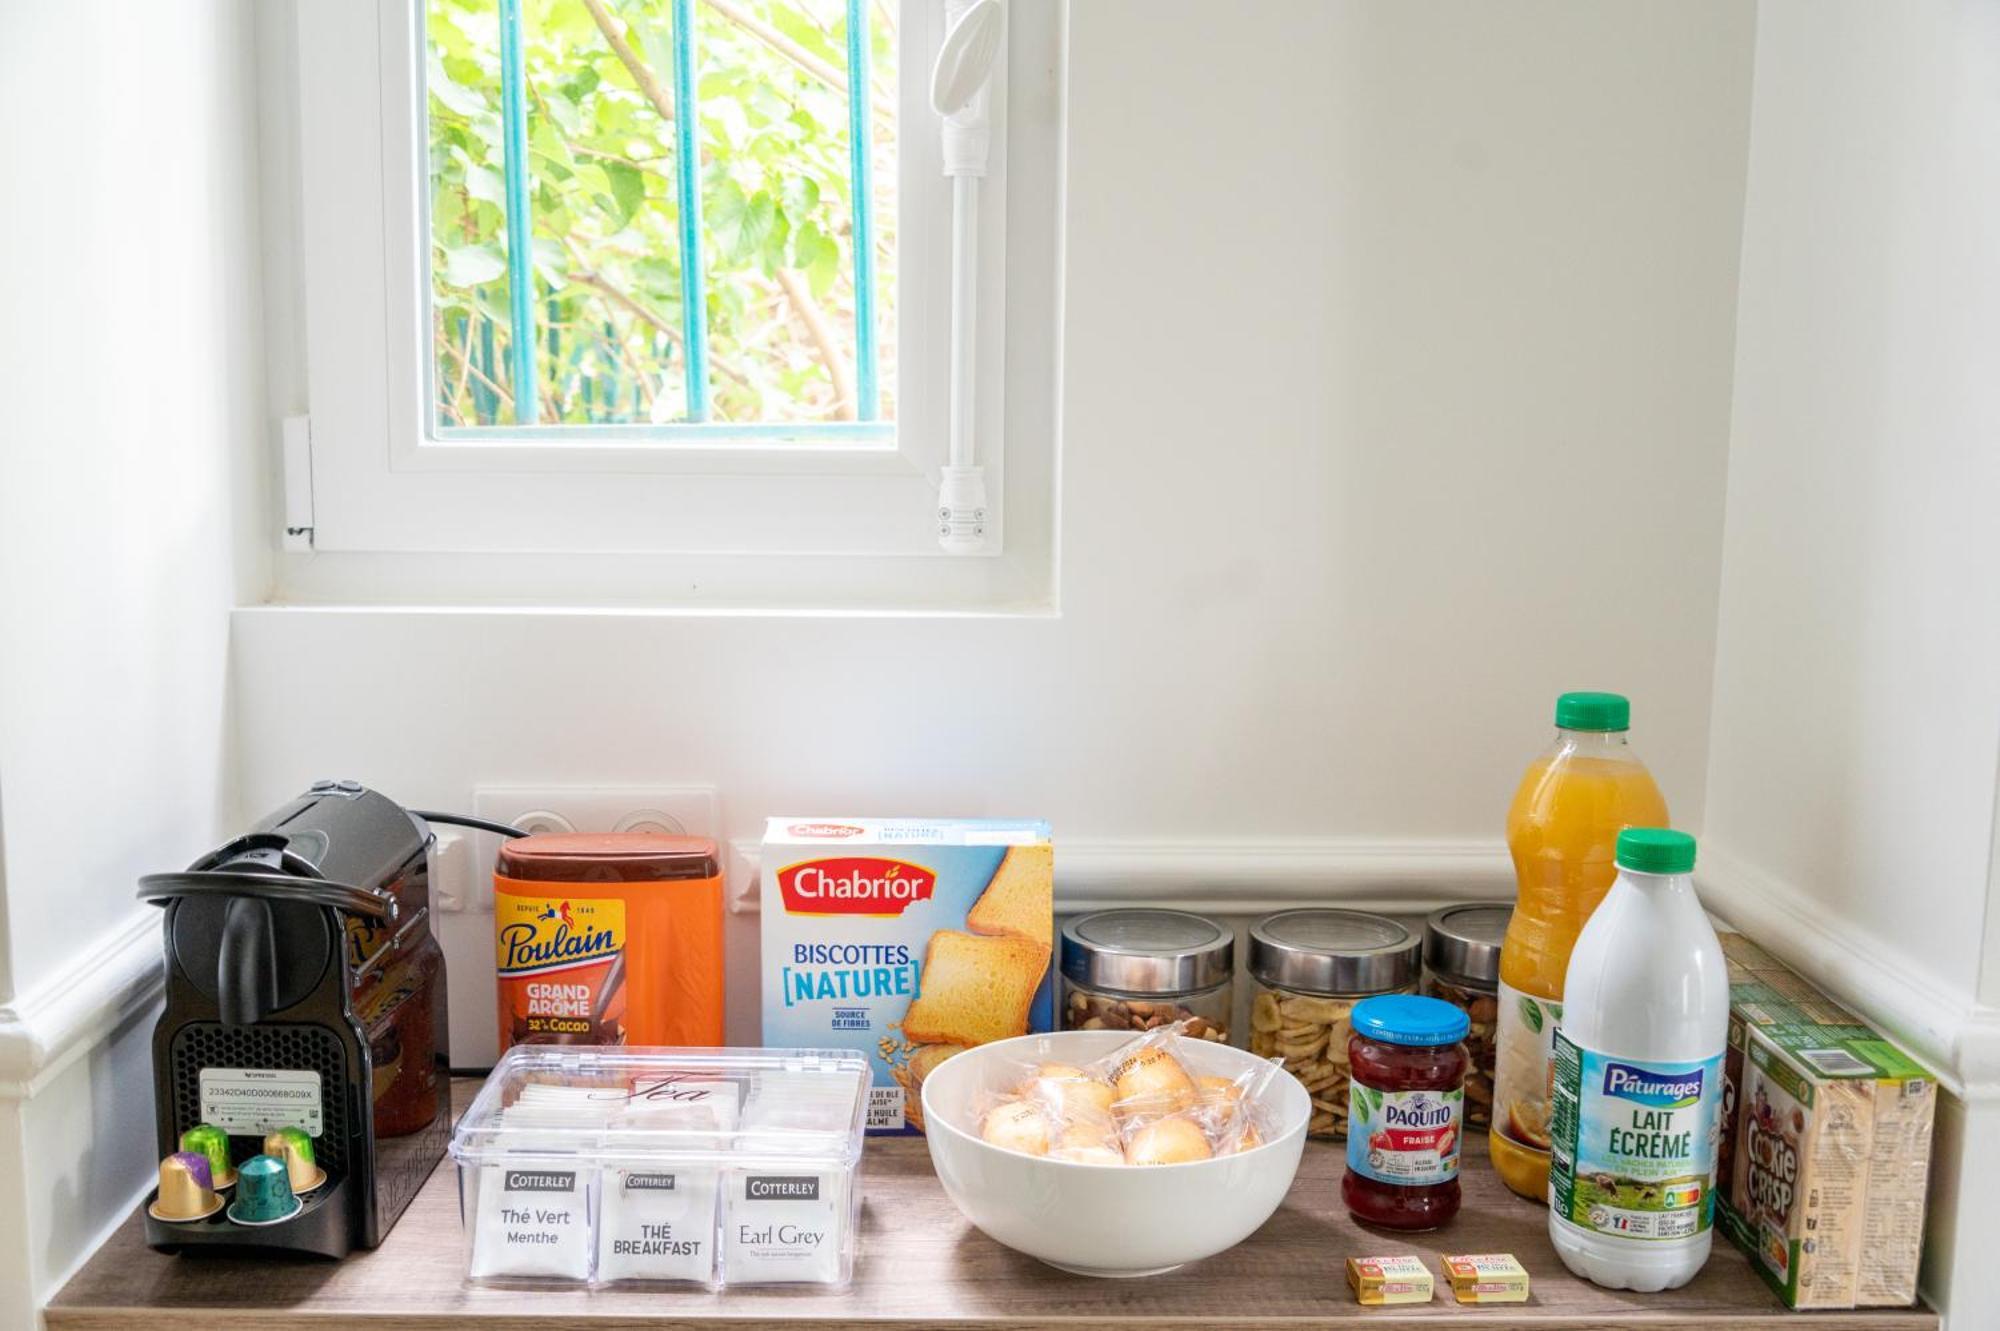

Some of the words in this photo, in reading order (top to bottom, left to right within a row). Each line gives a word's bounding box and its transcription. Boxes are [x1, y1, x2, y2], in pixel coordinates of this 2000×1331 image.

[794, 867, 923, 899] Chabrior
[501, 923, 616, 968] Poulain
[794, 943, 909, 965] BISCOTTES
[527, 983, 590, 1000] GRAND
[550, 1018, 590, 1032] Cacao
[1386, 1105, 1450, 1127] PAQUITO
[1632, 1109, 1674, 1131] LAIT
[1403, 1135, 1436, 1145] FRAISE
[1609, 1126, 1691, 1158] ÉCRÉMÉ
[1748, 1118, 1796, 1184] Cookie
[509, 1173, 573, 1188] COTTERLEY
[627, 1175, 674, 1187] COTTERLEY
[751, 1180, 815, 1196] COTTERLEY
[501, 1208, 531, 1224] Thé
[535, 1210, 570, 1224] Vert
[507, 1231, 559, 1244] Menthe
[641, 1222, 671, 1239] THÉ
[739, 1224, 773, 1244] Earl
[778, 1224, 825, 1248] Grey
[614, 1240, 702, 1256] BREAKFAST
